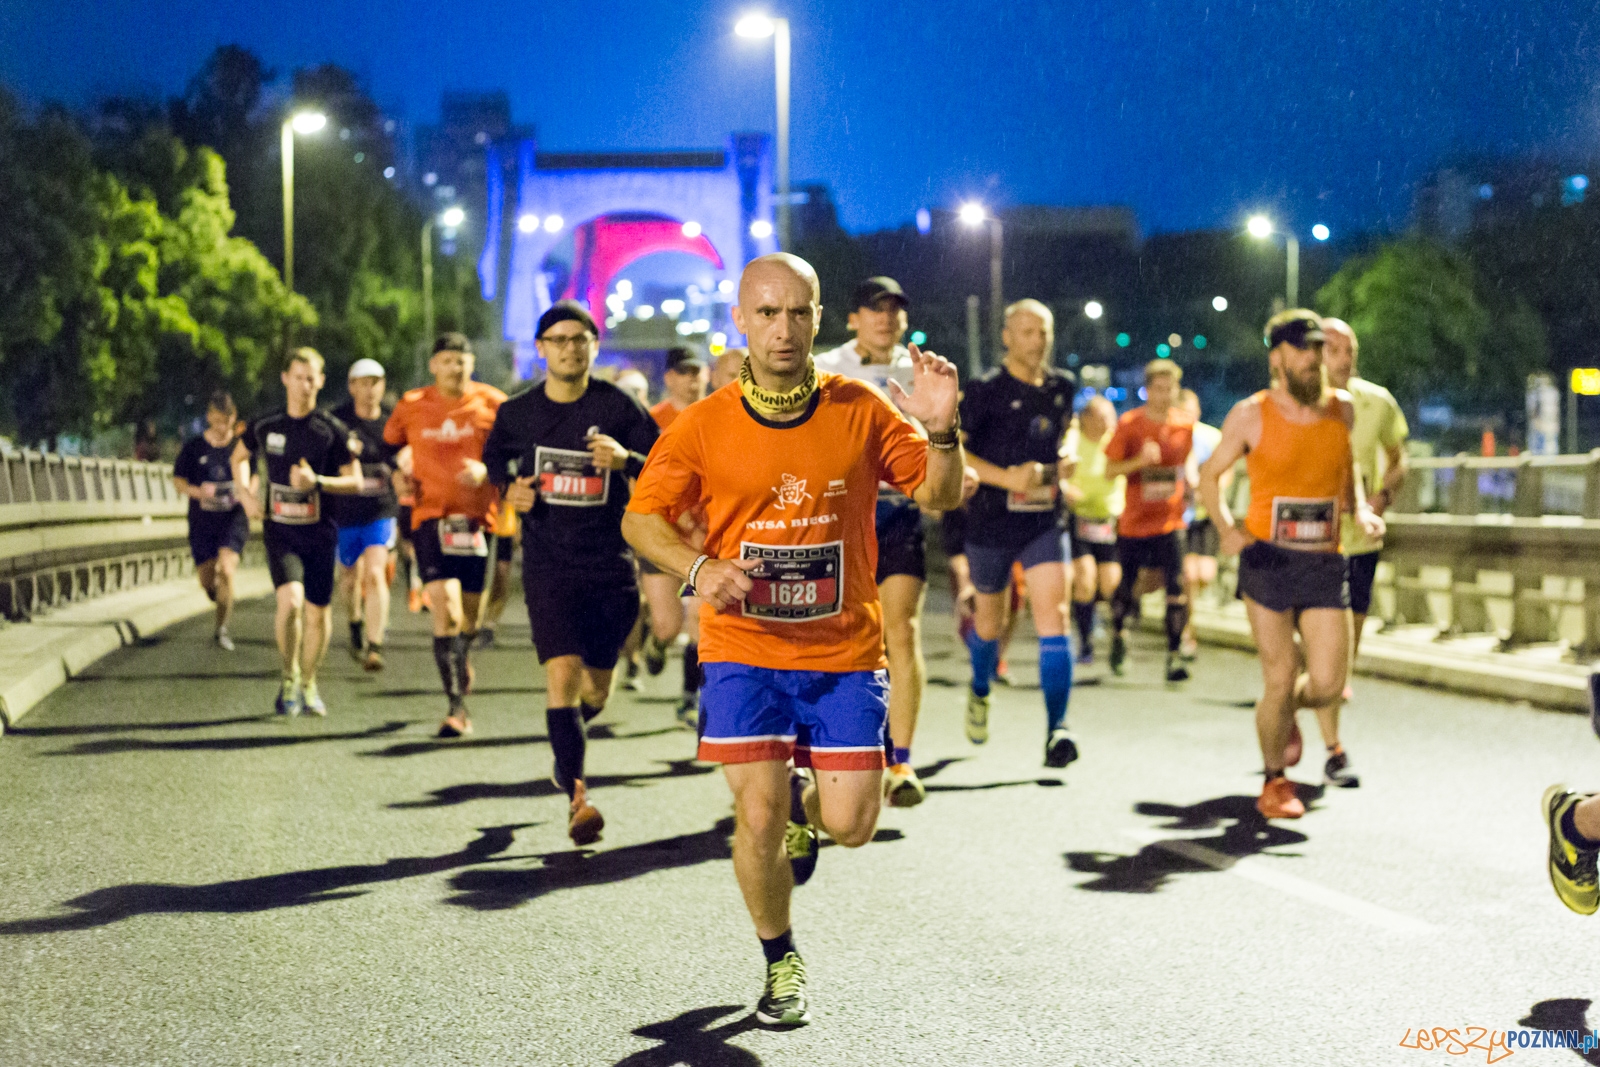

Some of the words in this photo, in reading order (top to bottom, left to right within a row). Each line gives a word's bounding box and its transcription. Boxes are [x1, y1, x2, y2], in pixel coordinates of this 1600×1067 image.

[745, 520, 787, 530] NYSA
[791, 513, 839, 528] BIEGA
[769, 582, 817, 605] 1628
